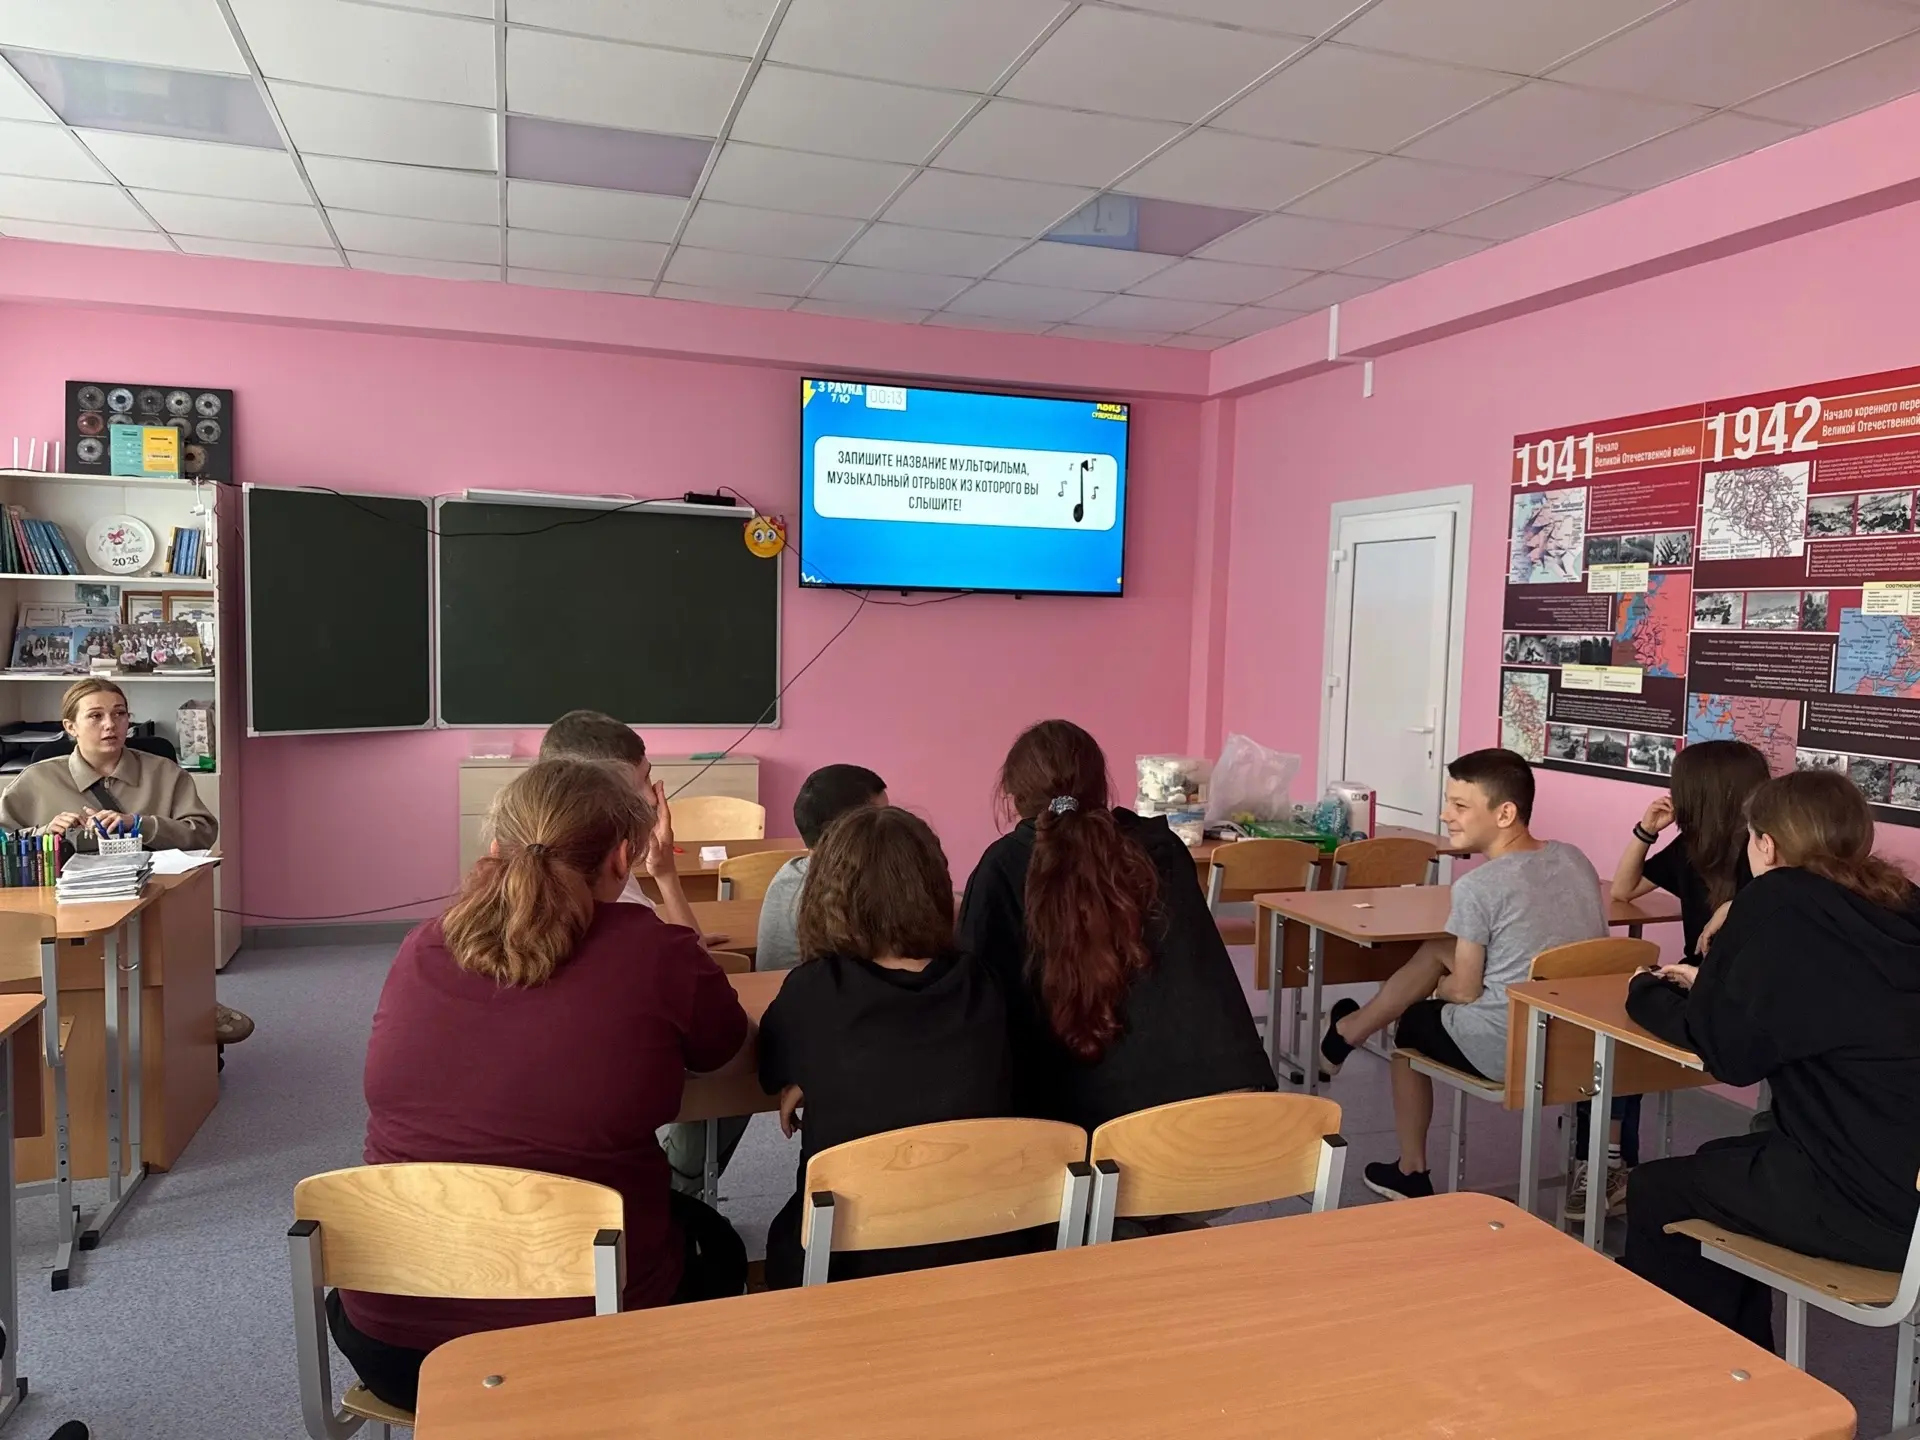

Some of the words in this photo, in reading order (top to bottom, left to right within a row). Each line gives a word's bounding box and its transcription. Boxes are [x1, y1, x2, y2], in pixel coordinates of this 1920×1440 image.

[831, 393, 851, 404] 7/10
[870, 388, 904, 406] 00:13
[1823, 409, 1853, 422] Начало
[1854, 403, 1898, 420] коренного
[1707, 396, 1821, 463] 1942
[1821, 422, 1856, 438] Великой
[1594, 455, 1621, 468] Великой
[1622, 447, 1672, 464] Отечественной
[1673, 445, 1696, 457] войны
[1595, 442, 1619, 454] Начало
[838, 450, 893, 467] ЗАПИШИТЕ
[895, 454, 947, 470] НАЗВАНИЕ
[949, 457, 1030, 476] МУЛЬТФИЛЬМА,
[1516, 432, 1594, 488] 1941
[827, 470, 909, 488] МУЗЫКАЛЬНЫЙ
[912, 475, 958, 491] ОТРЫВОК
[960, 479, 973, 492] ИЗ
[975, 479, 1022, 494] КОТОРОГО
[1024, 482, 1039, 495] ВЫ
[908, 496, 962, 512] СЛЫШИТЕ!
